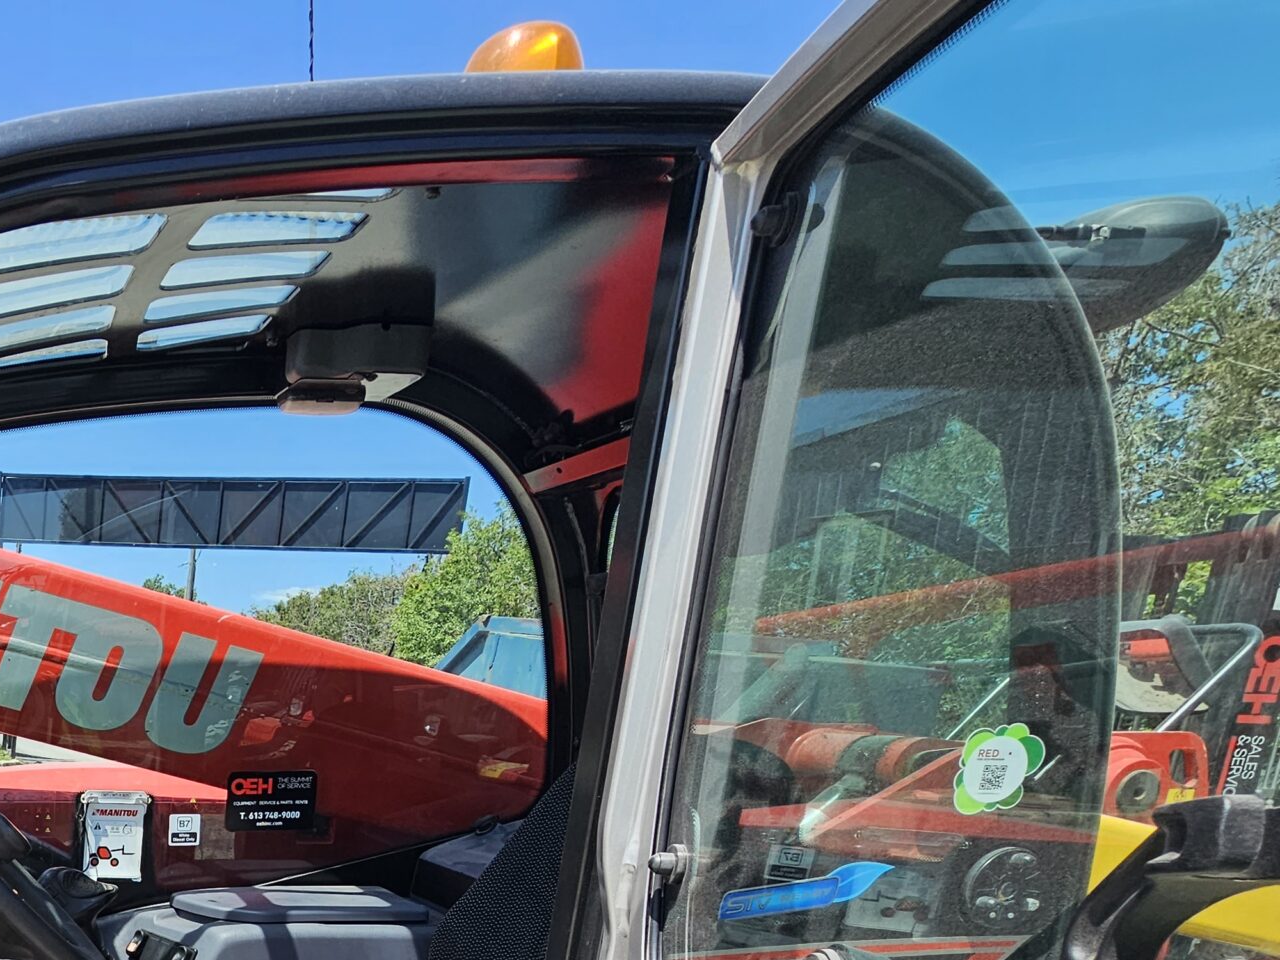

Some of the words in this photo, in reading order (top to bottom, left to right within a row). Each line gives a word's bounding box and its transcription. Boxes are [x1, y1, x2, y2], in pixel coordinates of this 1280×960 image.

[1236, 636, 1280, 724] OEH
[1237, 734, 1252, 746] &
[978, 748, 1000, 758] RED
[1241, 735, 1266, 780] SALES
[1222, 747, 1248, 797] SERVIC
[231, 777, 273, 795] OEH
[98, 809, 138, 817] MANITOU
[240, 811, 248, 820] T.
[248, 811, 263, 820] 613
[265, 811, 301, 819] 748-9000
[179, 820, 190, 828] B7
